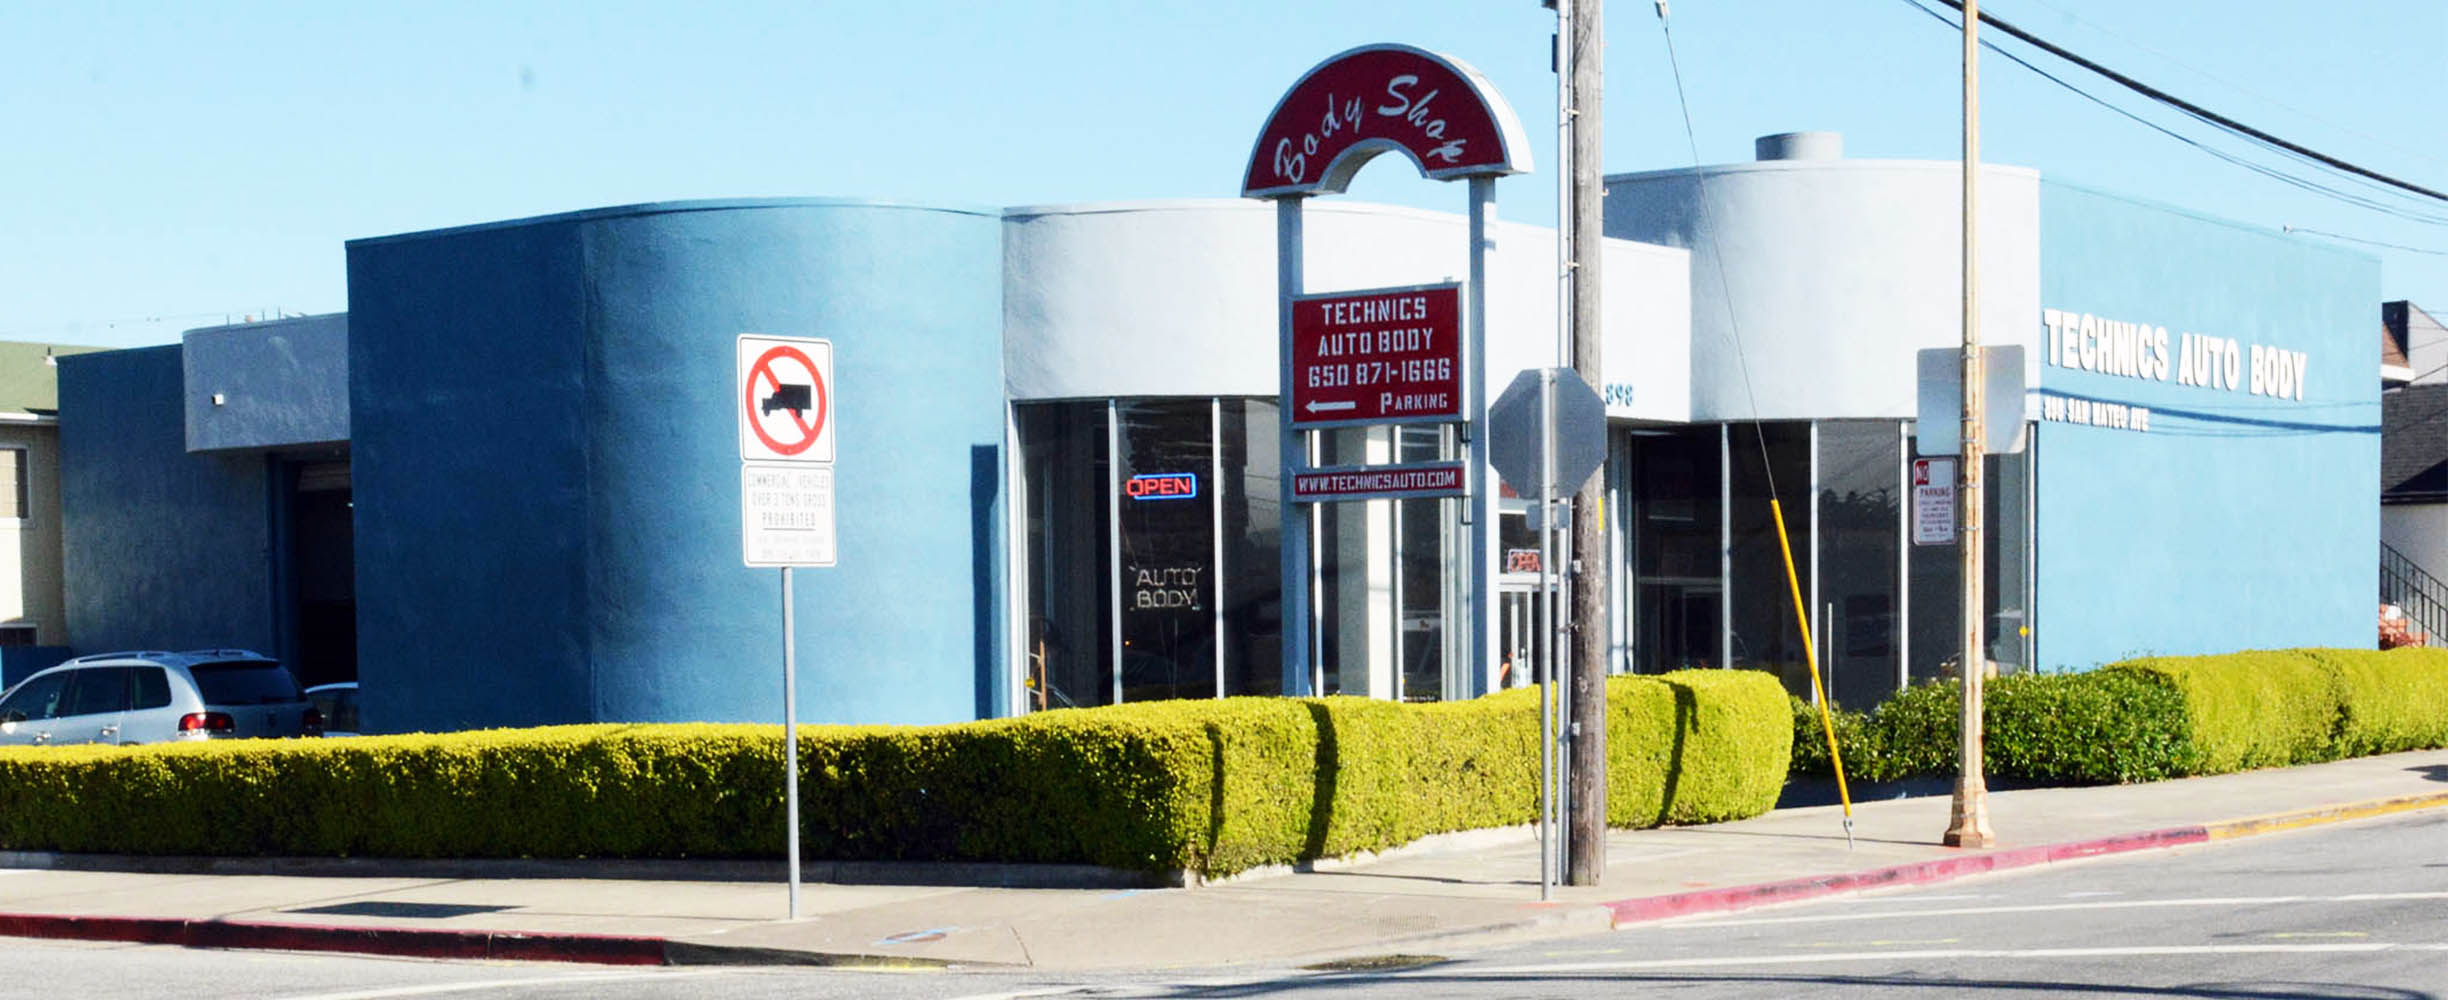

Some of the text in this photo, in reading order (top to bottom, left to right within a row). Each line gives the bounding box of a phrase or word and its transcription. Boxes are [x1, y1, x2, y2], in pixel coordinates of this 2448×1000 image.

[1274, 74, 1467, 183] Body Shop
[1321, 297, 1427, 325] TECHNICS
[1318, 328, 1433, 357] AUTO BODY
[2043, 308, 2307, 401] TECHNICS AUTO BODY
[1308, 358, 1450, 388] 650 871-1666
[1606, 383, 1633, 407] 898
[2066, 397, 2091, 424] SAN
[2091, 401, 2128, 429] MATEO
[2129, 406, 2150, 432] AVE
[1298, 472, 1455, 492] WWW.TECHNICSAUTO.COM
[1916, 464, 1928, 481] NO
[1125, 477, 1192, 496] OPEN
[762, 511, 816, 528] PROHIBITED
[1136, 568, 1197, 587] AUTO
[1137, 589, 1196, 608] BODY
